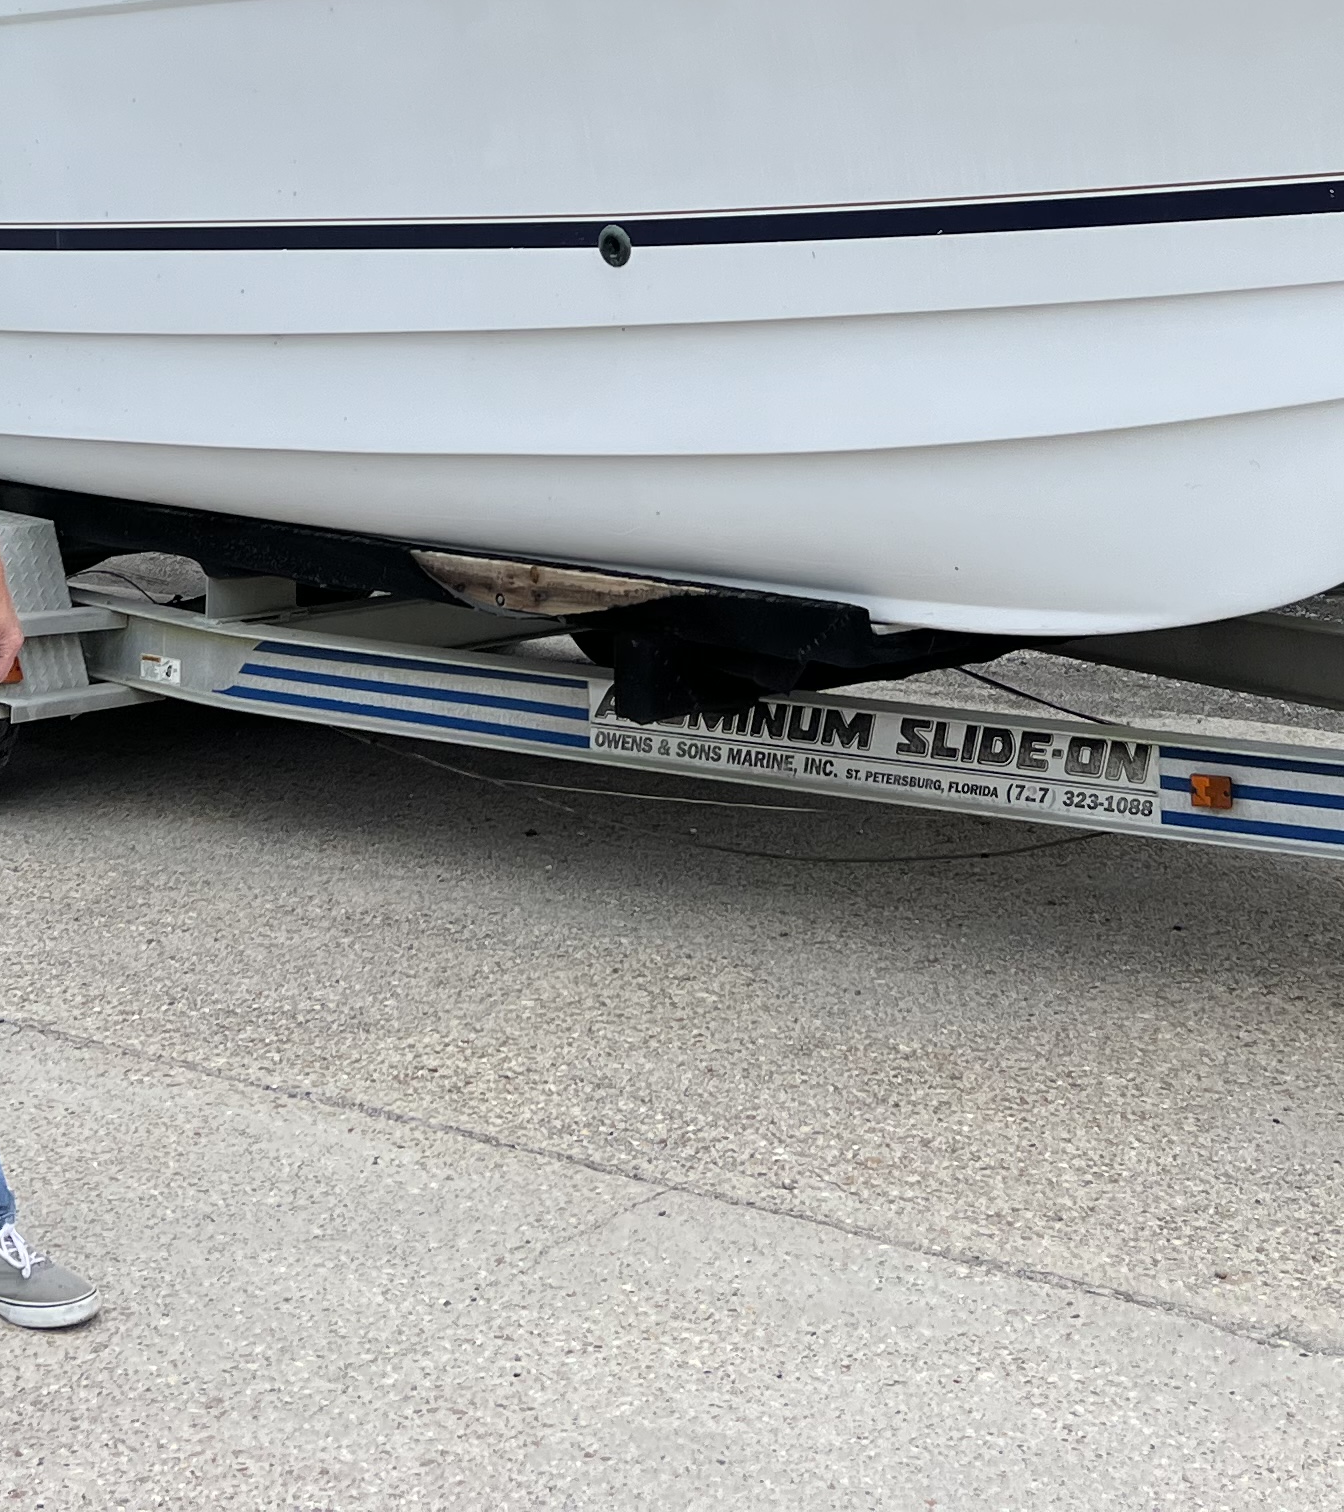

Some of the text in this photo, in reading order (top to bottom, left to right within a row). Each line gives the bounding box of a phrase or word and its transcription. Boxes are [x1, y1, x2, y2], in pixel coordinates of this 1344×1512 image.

[595, 731, 838, 778] OWENS & SONS MARINE, INC.
[896, 718, 1152, 784] SLIDE-ON
[845, 768, 999, 798] ST. PETERSBURG, FLORIDA
[1062, 790, 1153, 816] 323-1088
